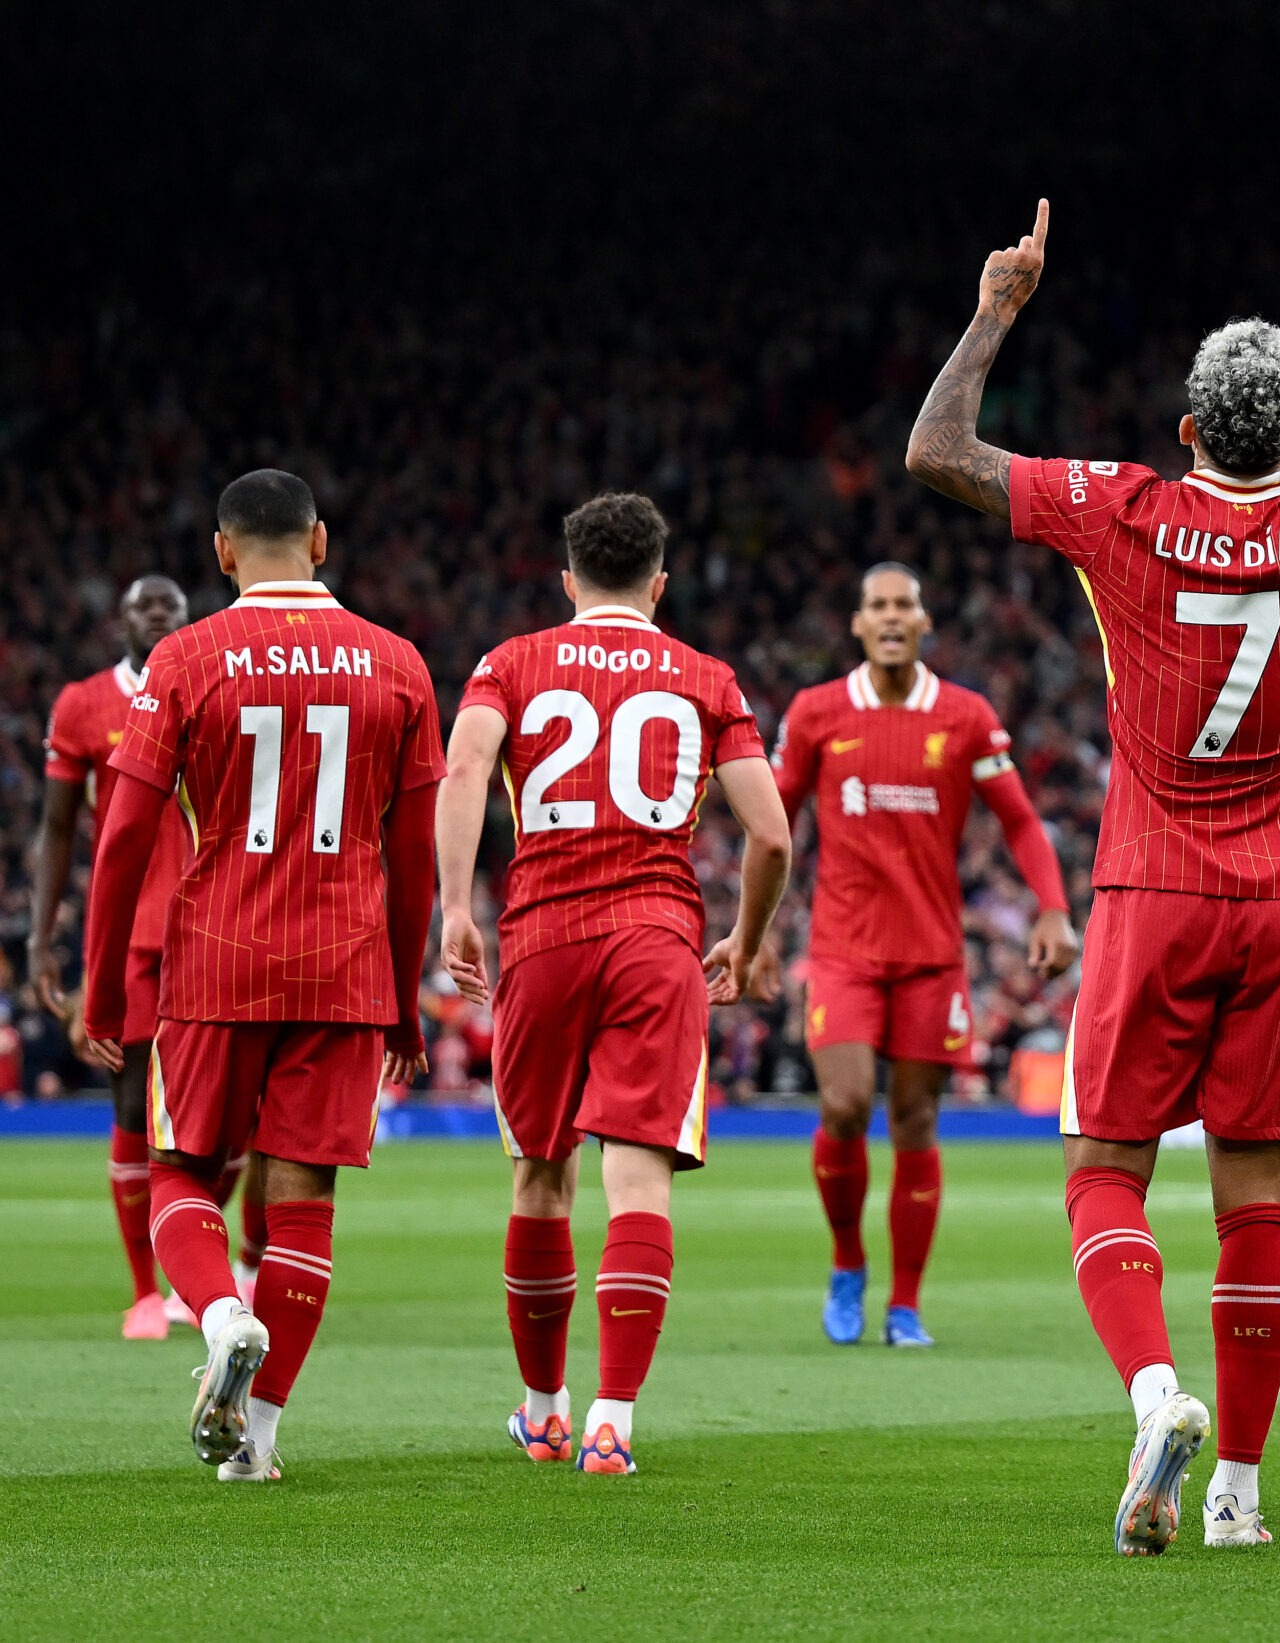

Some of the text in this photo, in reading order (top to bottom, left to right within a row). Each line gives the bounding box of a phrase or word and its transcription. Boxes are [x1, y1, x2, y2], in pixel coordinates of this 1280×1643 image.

[1068, 459, 1089, 504] edia
[1155, 523, 1234, 568] LUIS
[224, 645, 372, 678] M.SALAH
[557, 643, 681, 675] DIOGO J.
[1175, 590, 1280, 758] 7
[520, 688, 702, 834] 20
[240, 704, 350, 854] 11
[201, 1220, 226, 1236] LFC
[1120, 1261, 1154, 1274] LFC
[286, 1288, 317, 1305] LFC
[1233, 1326, 1271, 1338] LFC
